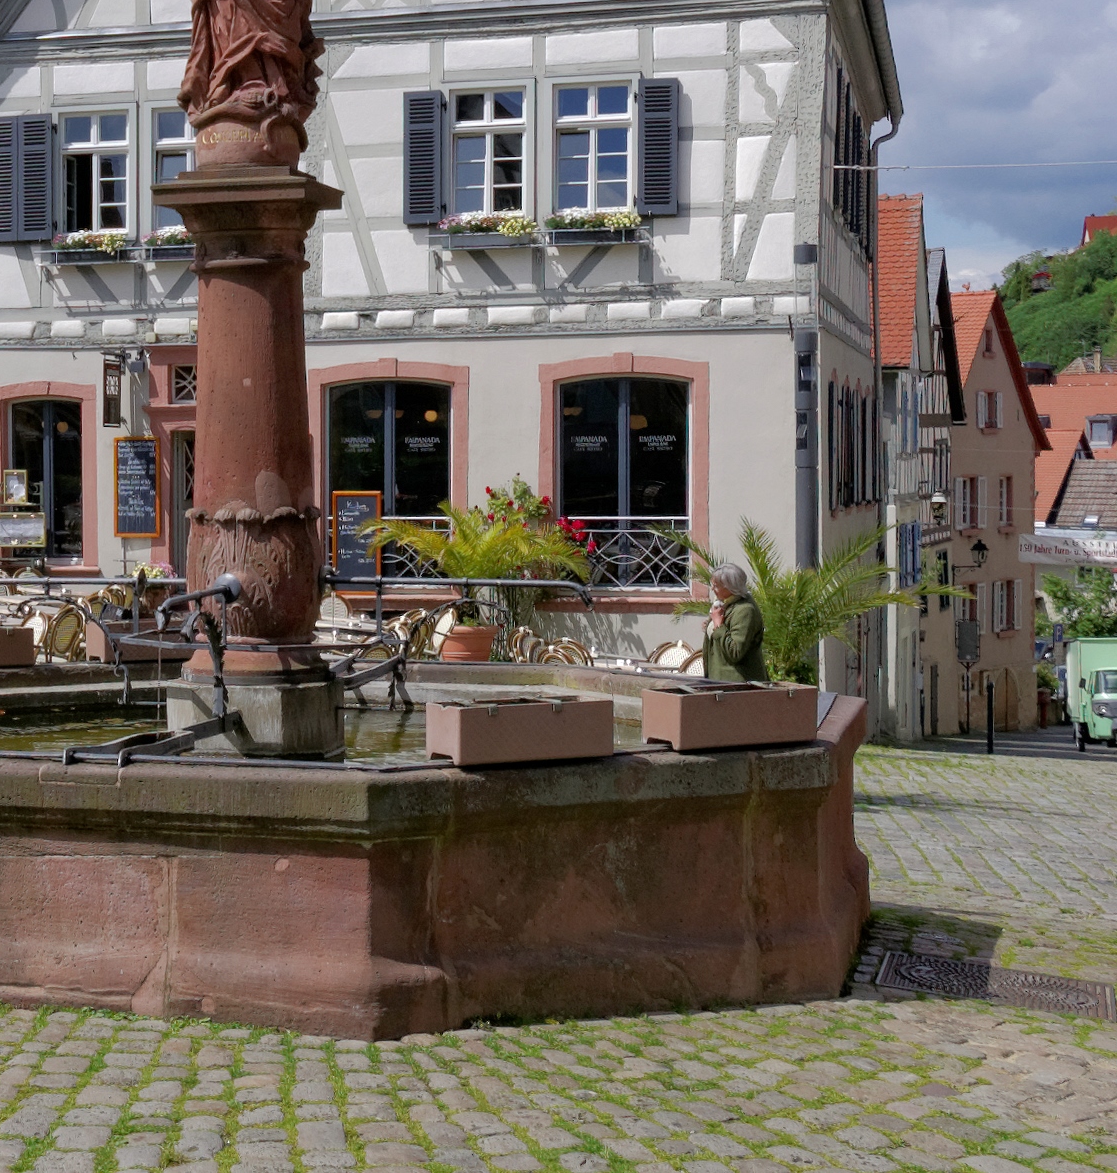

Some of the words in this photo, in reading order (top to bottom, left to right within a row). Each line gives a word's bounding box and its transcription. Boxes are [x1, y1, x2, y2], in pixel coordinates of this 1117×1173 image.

[1019, 543, 1033, 553] 150
[1034, 543, 1053, 555] Jahre
[1082, 547, 1117, 560] Sportstad
